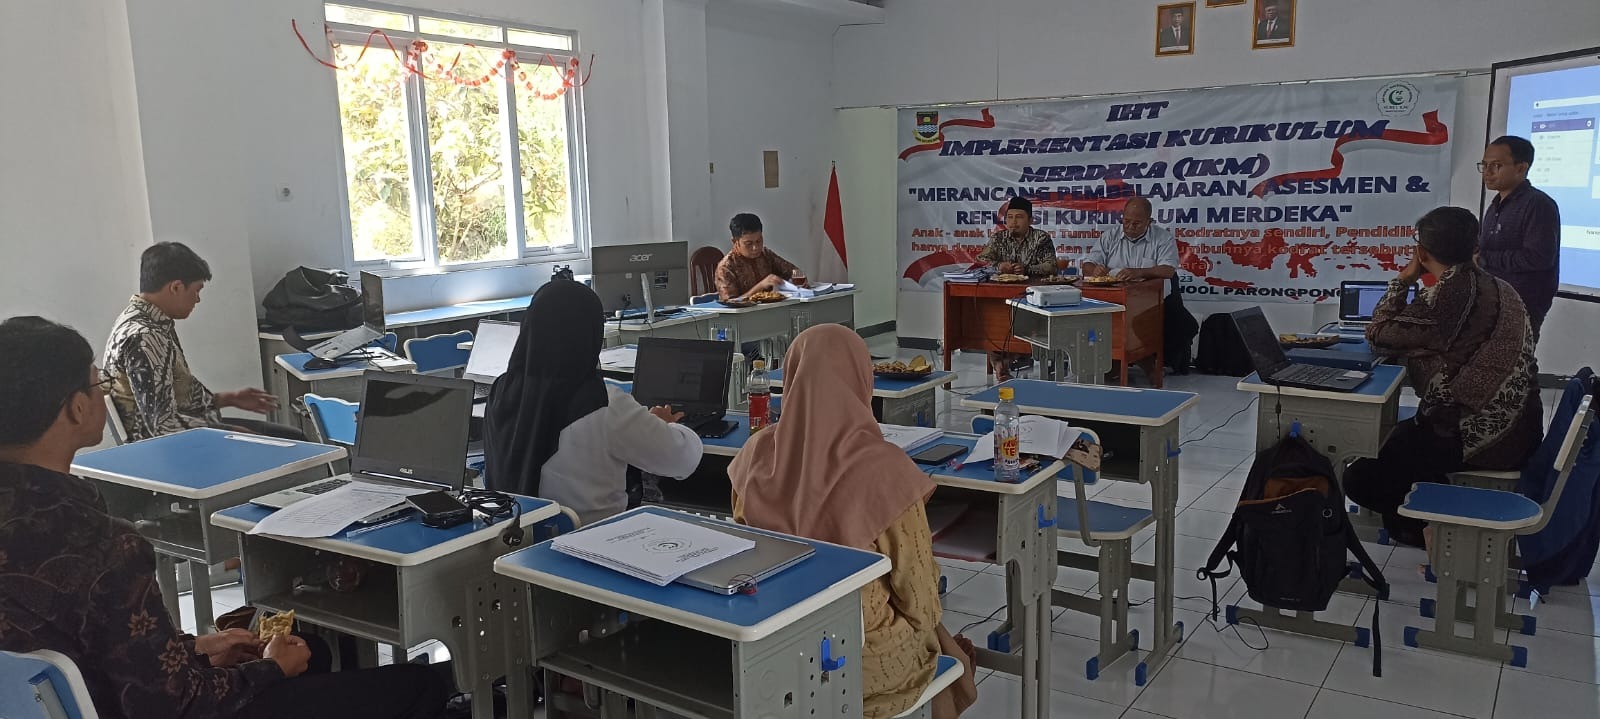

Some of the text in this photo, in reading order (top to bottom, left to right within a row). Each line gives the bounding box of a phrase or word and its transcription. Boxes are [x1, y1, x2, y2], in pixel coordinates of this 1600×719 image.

[1106, 101, 1169, 122] IHT
[939, 119, 1390, 156] IMPLEMENTASI KURIKULUM
[1019, 153, 1271, 182] MERDEKA (IKM)
[909, 186, 1050, 202] "MERANCANG
[1263, 176, 1397, 195] ASESMEN
[1405, 175, 1431, 193] &
[956, 205, 1352, 226] REFLSI KURIKUM MERDEKA"
[912, 228, 944, 238] Anak
[953, 228, 985, 238] anak
[1175, 227, 1260, 240] Kodratnya
[629, 253, 654, 262] acer
[1056, 243, 1083, 254] dan
[1178, 243, 1263, 256] umbuhnya
